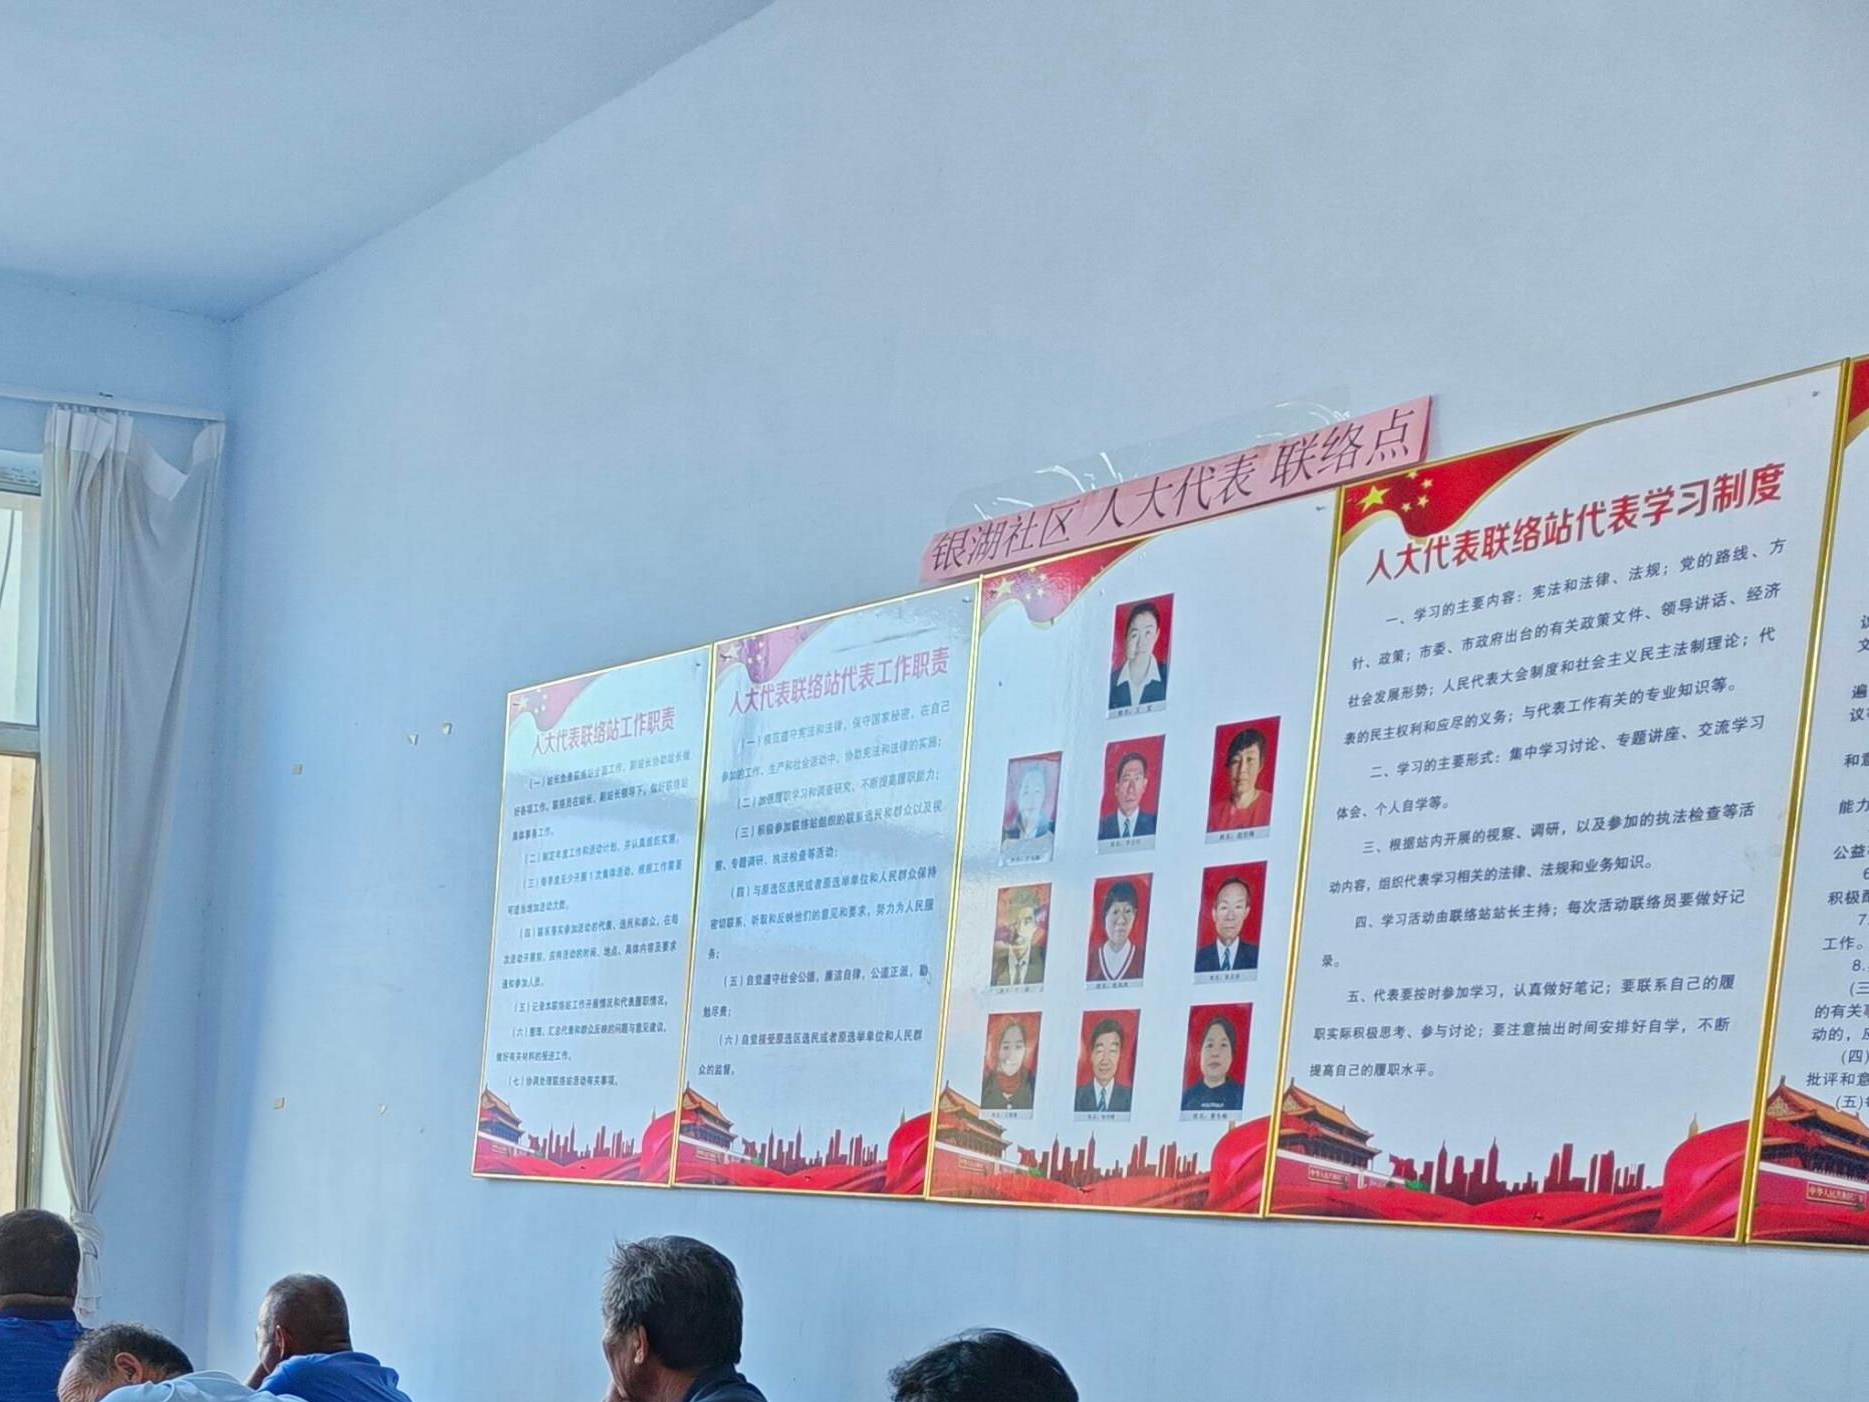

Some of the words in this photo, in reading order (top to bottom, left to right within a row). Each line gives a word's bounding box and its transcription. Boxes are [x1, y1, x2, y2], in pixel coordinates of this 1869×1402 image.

[930, 498, 1080, 572] 银湖社区
[1086, 452, 1260, 536] 人大代表
[1271, 407, 1416, 487] 联络点
[1365, 462, 1787, 585] 人大代表联络站代表学习制度
[728, 647, 950, 717] 人大代表联络站代表工作职责
[1335, 793, 1450, 821] 体会、个人自学等。
[1833, 842, 1869, 860] 公益
[1822, 935, 1865, 951] 工作。
[1321, 952, 1341, 969] 录。
[1309, 1062, 1436, 1078] 提高自己的履职水平。
[1834, 1094, 1869, 1111] (五)
